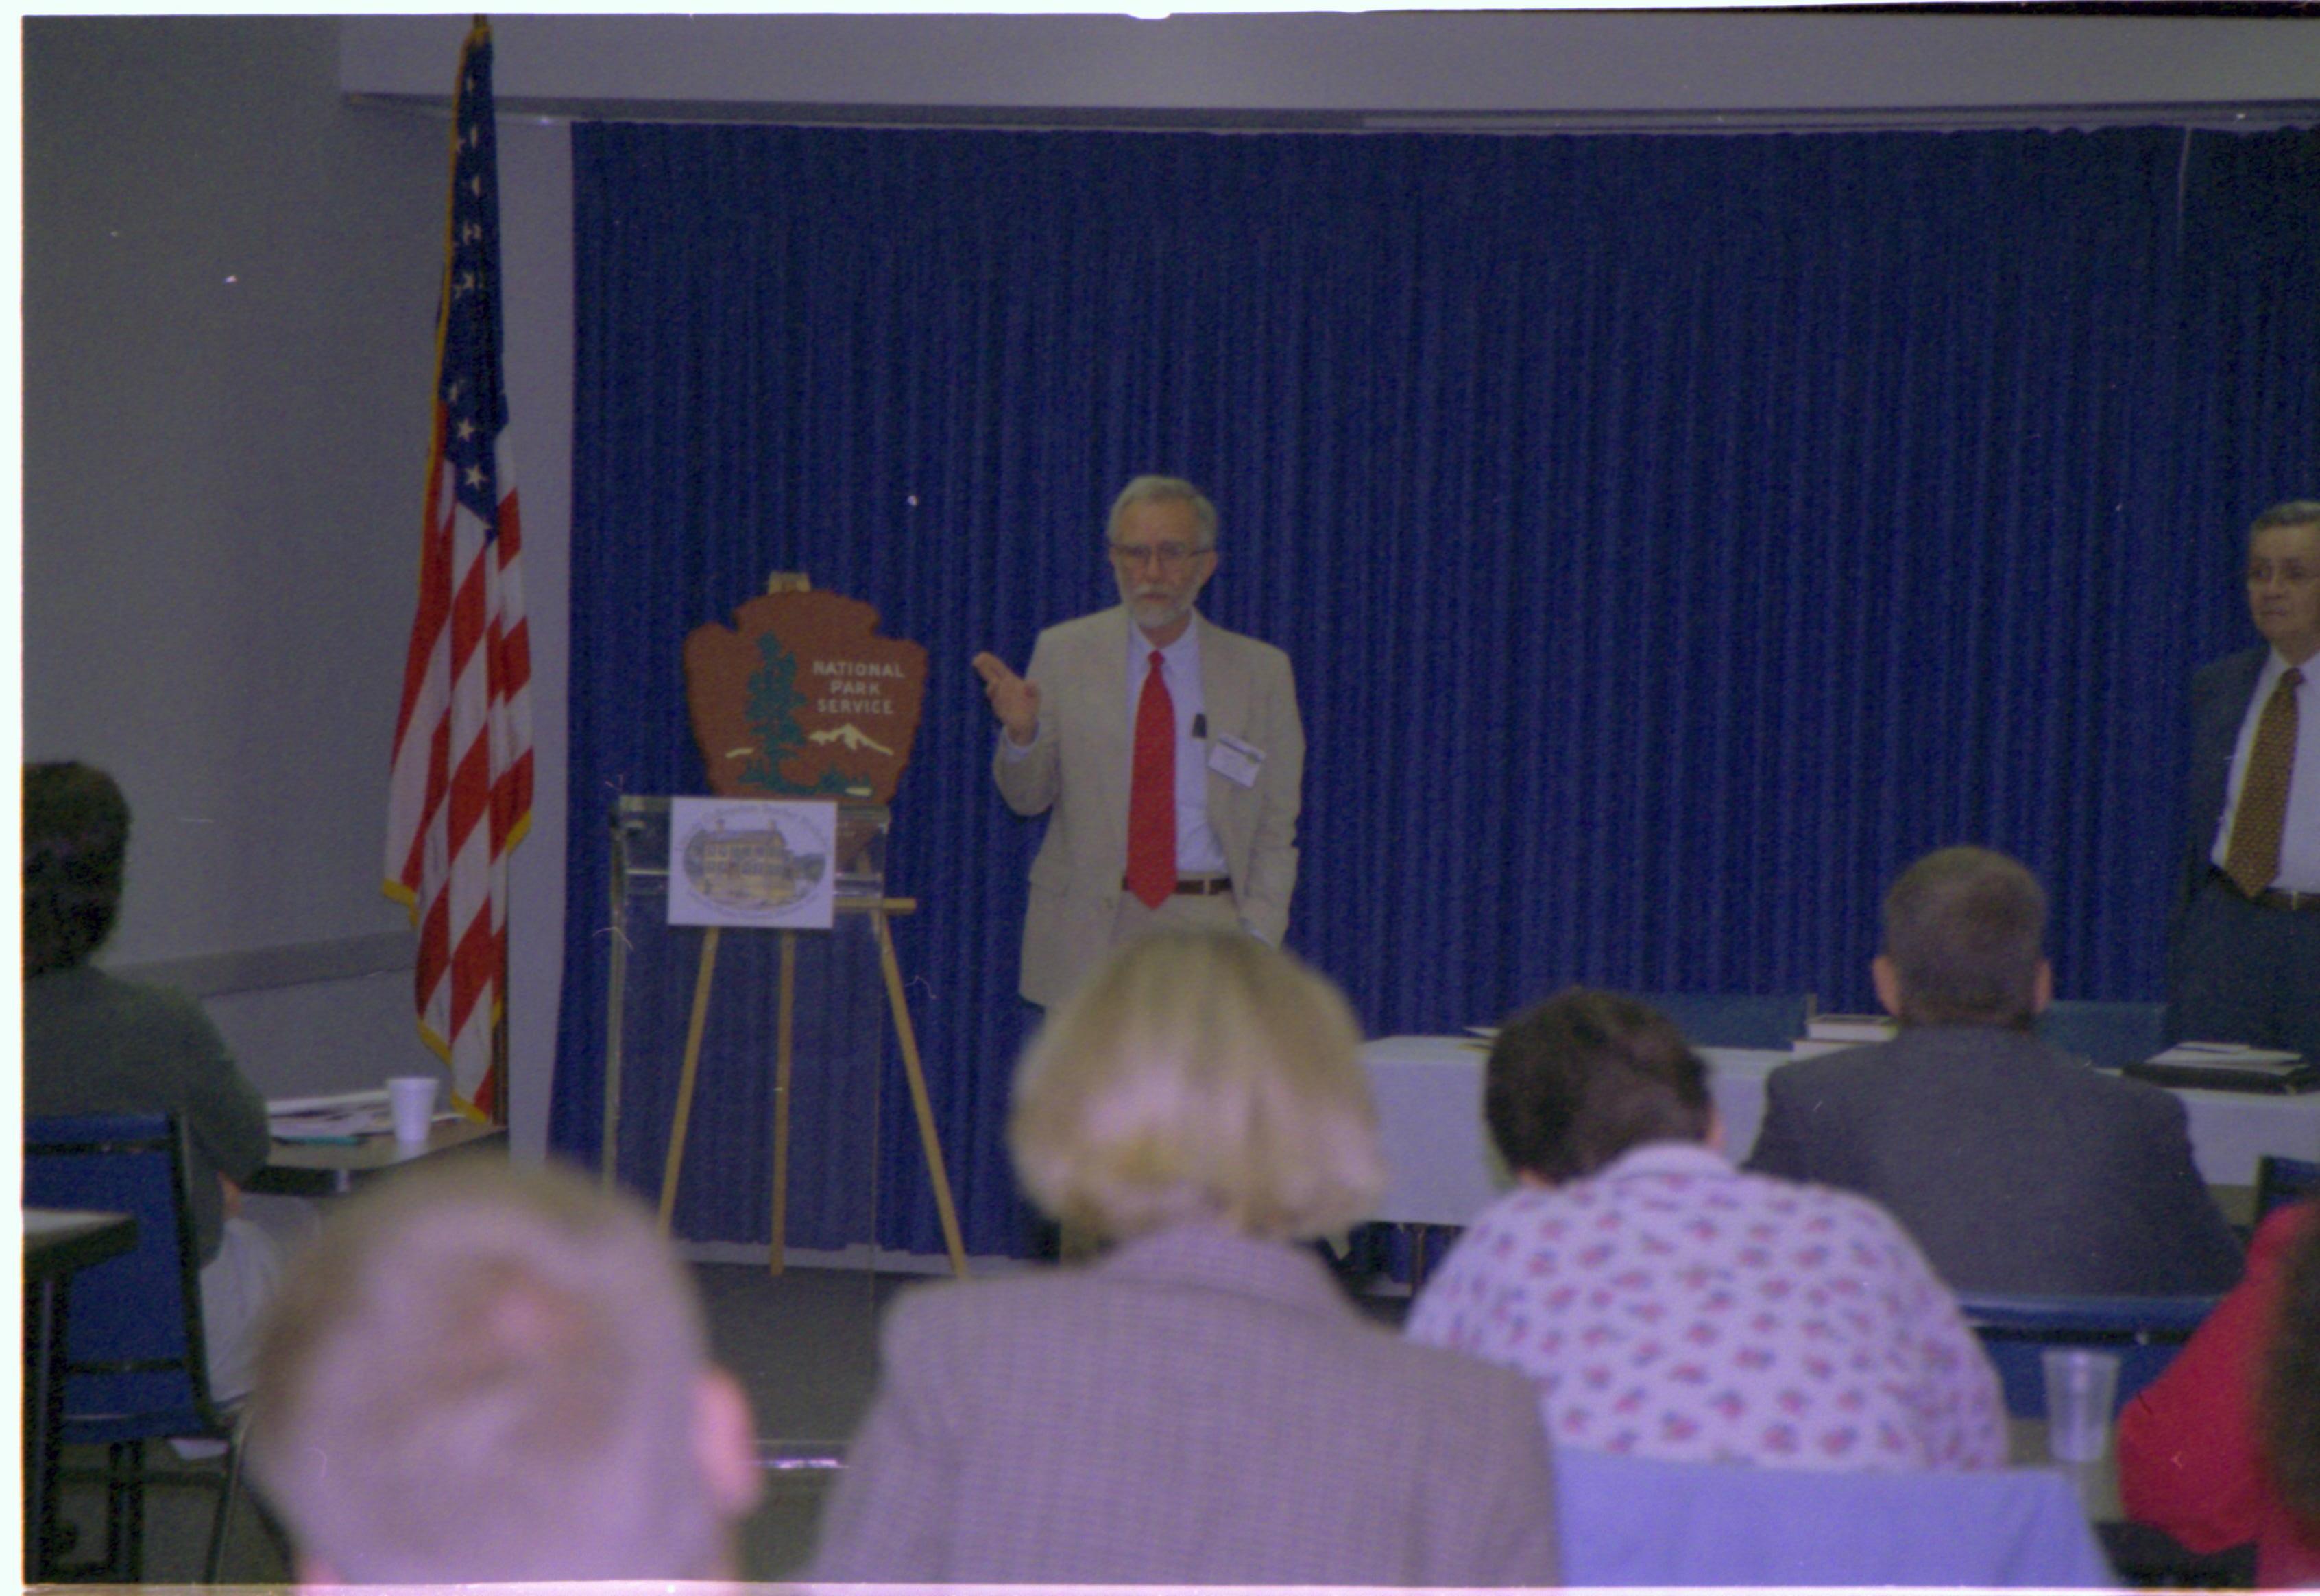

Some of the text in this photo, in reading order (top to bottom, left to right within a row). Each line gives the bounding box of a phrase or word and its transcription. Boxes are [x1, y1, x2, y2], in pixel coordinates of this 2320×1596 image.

[813, 661, 904, 677] NATIONAL
[830, 680, 880, 695] PARK
[817, 699, 892, 714] SERVICE
